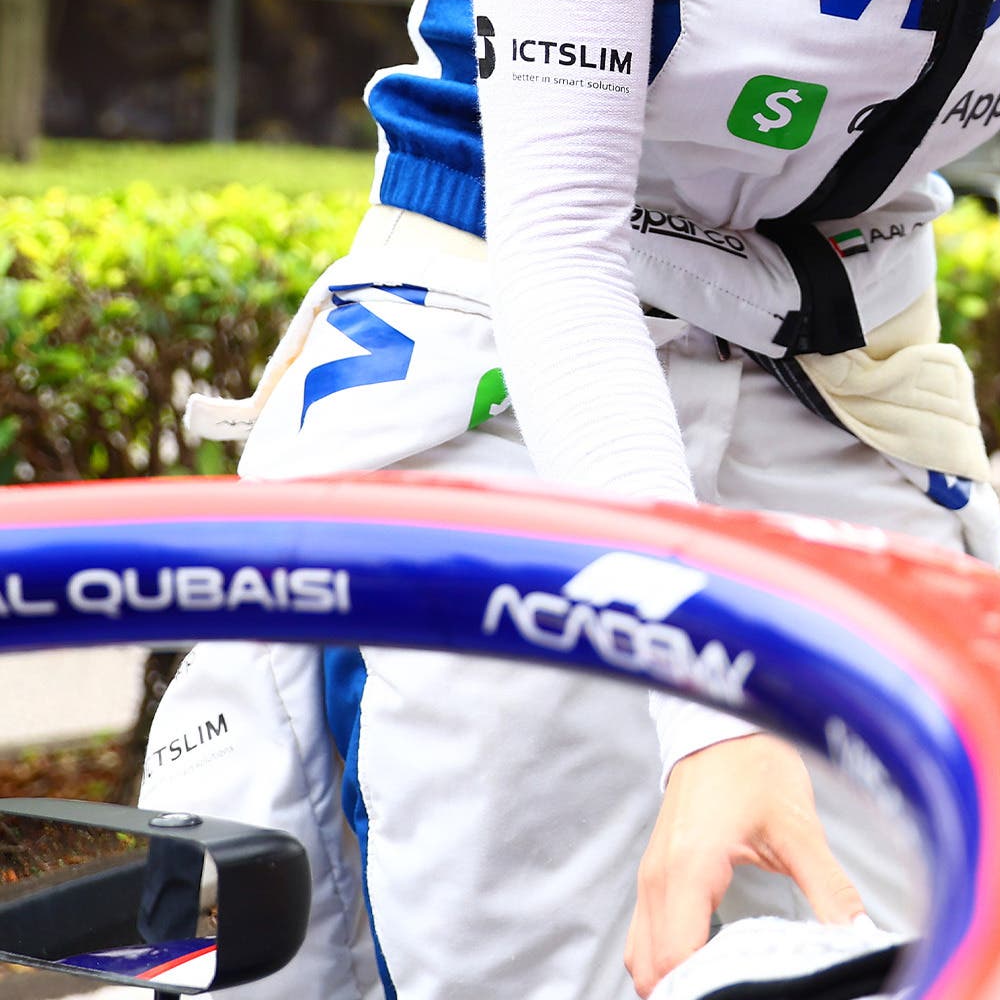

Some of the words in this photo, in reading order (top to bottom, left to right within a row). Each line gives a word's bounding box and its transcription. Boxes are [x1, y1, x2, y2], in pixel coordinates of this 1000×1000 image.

[512, 39, 633, 75] ICTSLIM
[512, 72, 539, 83] better
[553, 77, 584, 88] smart
[587, 80, 631, 94] solutions
[0, 572, 58, 618] L
[66, 565, 353, 621] QUBAISI
[146, 713, 229, 779] TSLIM
